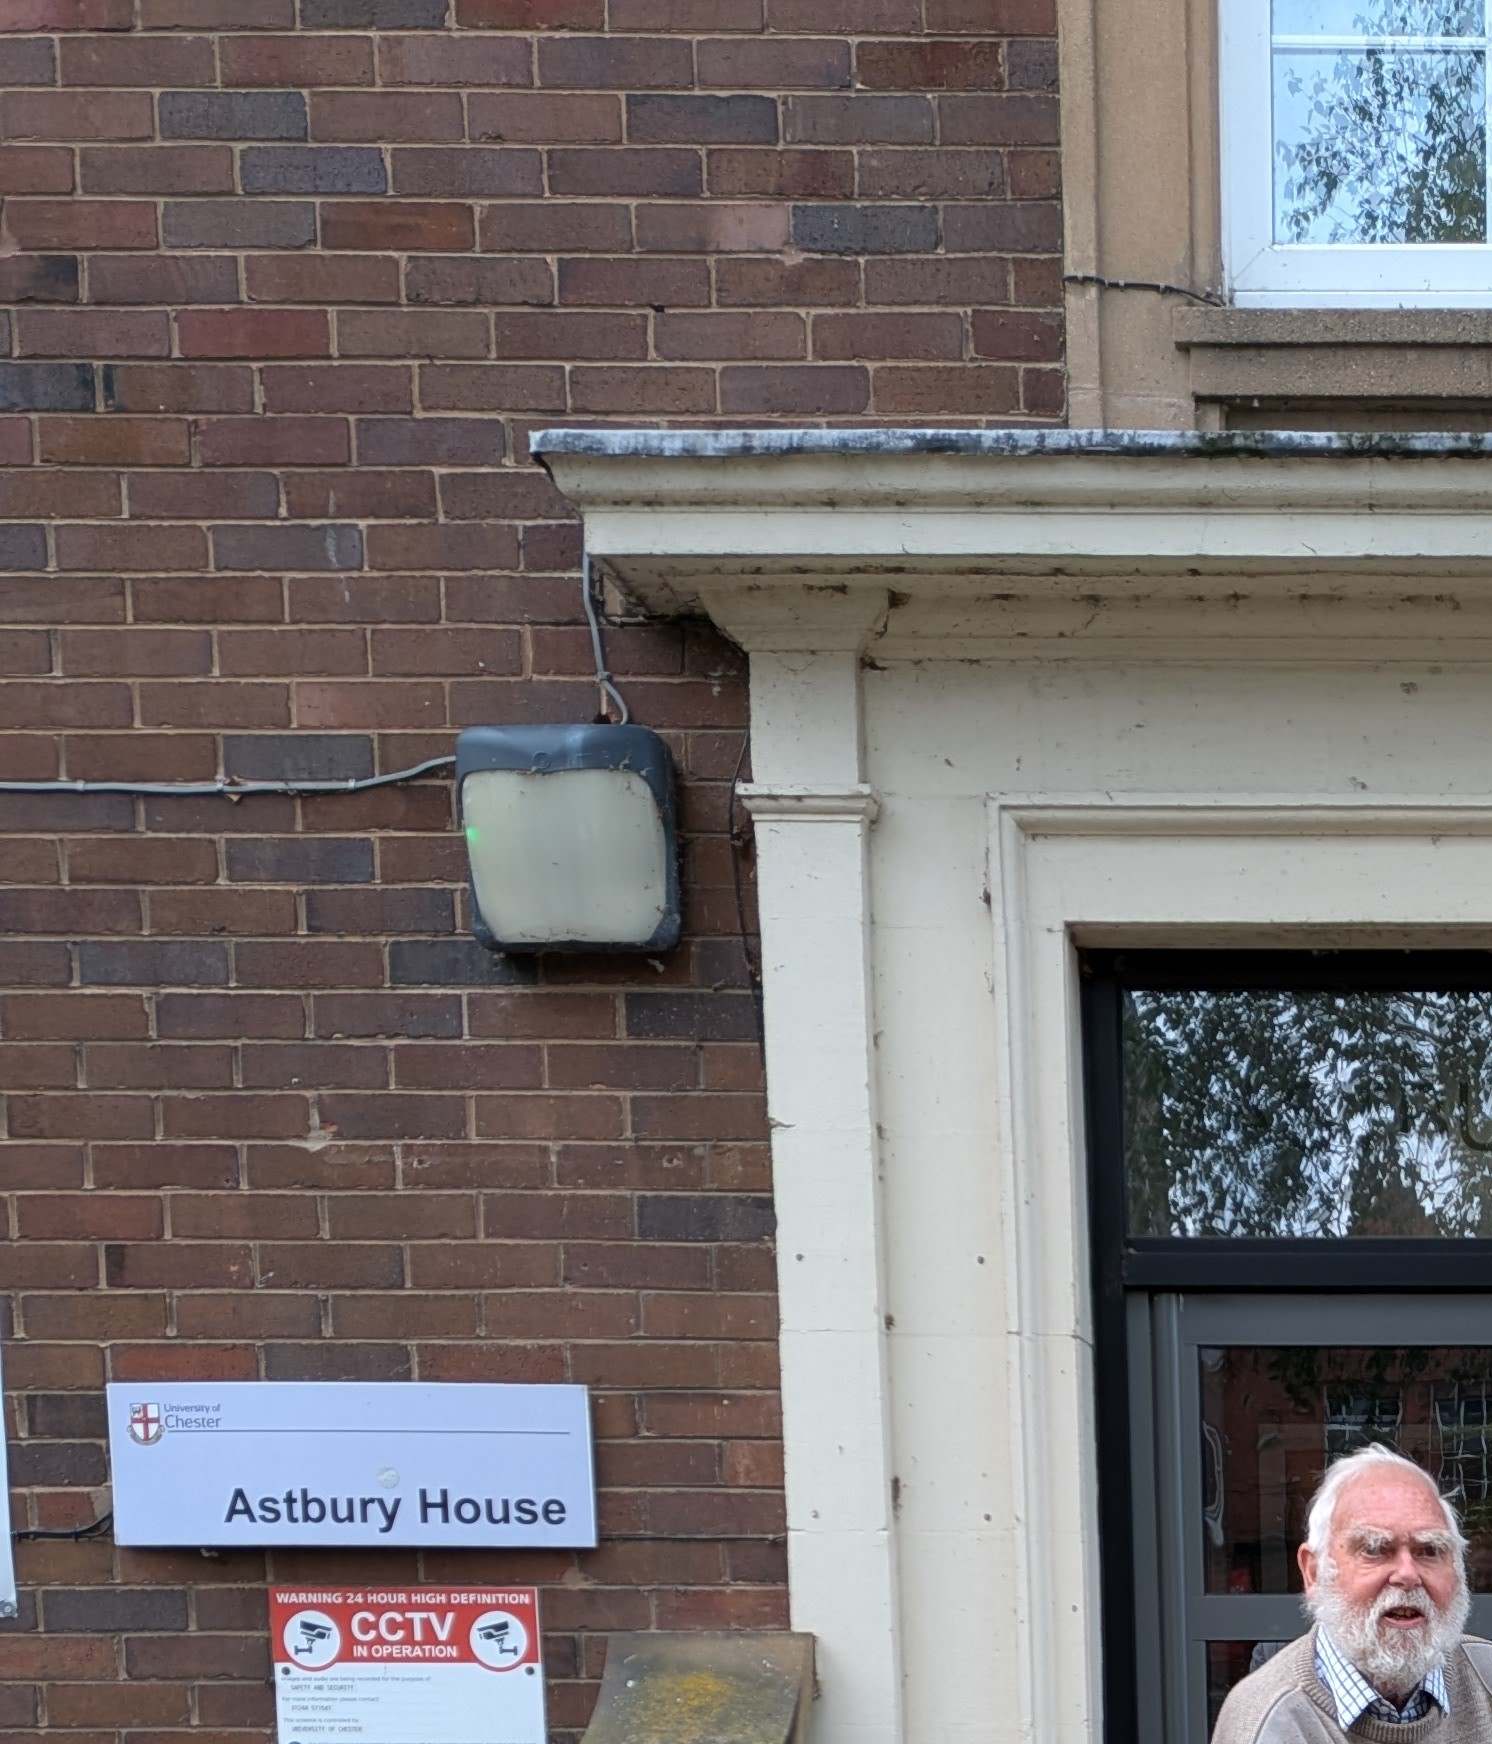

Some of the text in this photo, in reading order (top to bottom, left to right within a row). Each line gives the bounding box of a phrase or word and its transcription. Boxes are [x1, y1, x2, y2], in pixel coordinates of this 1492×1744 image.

[163, 1403, 221, 1413] University of
[164, 1414, 221, 1428] Chester
[224, 1487, 567, 1533] Astbury House
[276, 1593, 529, 1605] WARNING 24 HOUR HIGH DEFINITION
[350, 1611, 455, 1641] CCTV
[353, 1645, 457, 1657] IN OPERATION
